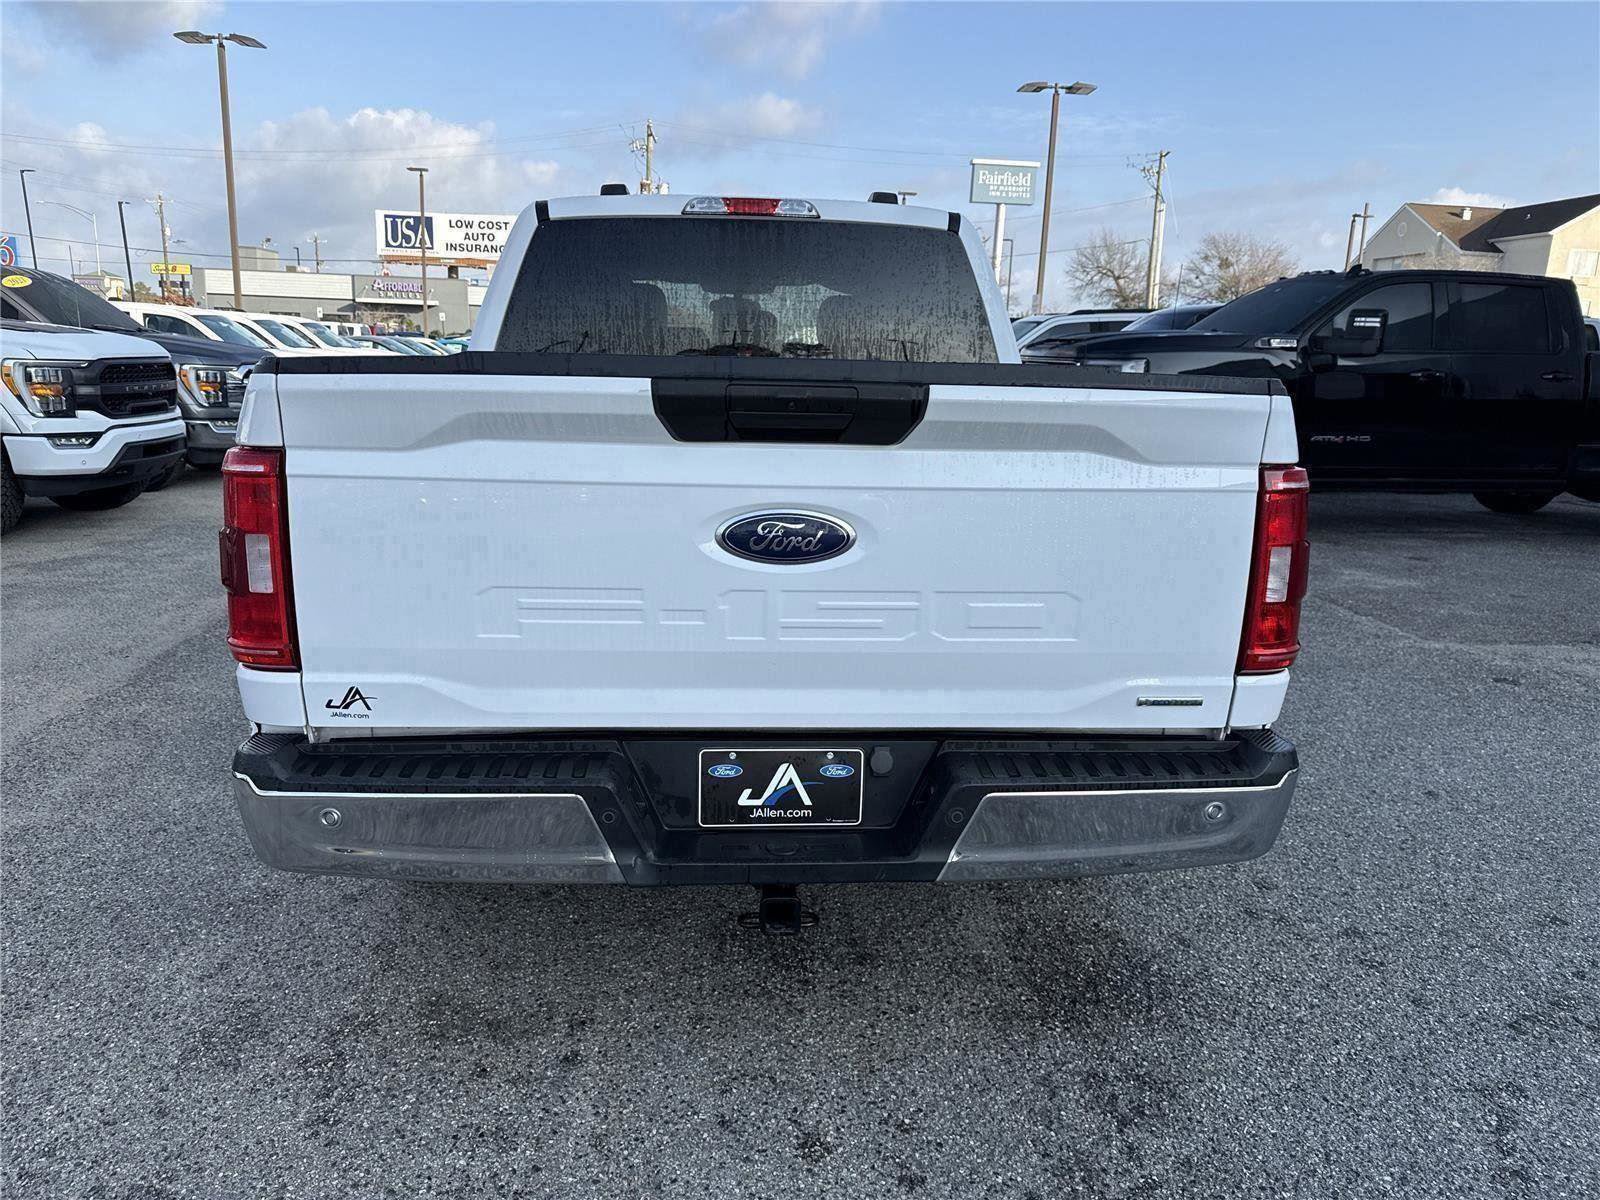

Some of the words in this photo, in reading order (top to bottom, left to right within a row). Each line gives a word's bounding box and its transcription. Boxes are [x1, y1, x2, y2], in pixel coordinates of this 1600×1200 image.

[978, 170, 1031, 186] Fairfield
[449, 219, 474, 229] LOW
[478, 220, 510, 231] COST
[385, 217, 432, 248] USA
[463, 232, 496, 242] AUTO
[445, 242, 505, 253] INSURANC
[372, 279, 424, 293] AFFORDABL
[379, 290, 421, 299] SMILES
[750, 521, 825, 552] Ford
[475, 586, 1080, 642] F-150
[330, 711, 370, 719] JAllen.com
[714, 766, 736, 776] Ford
[826, 766, 848, 776] Ford
[749, 807, 812, 818] JAllen.com
